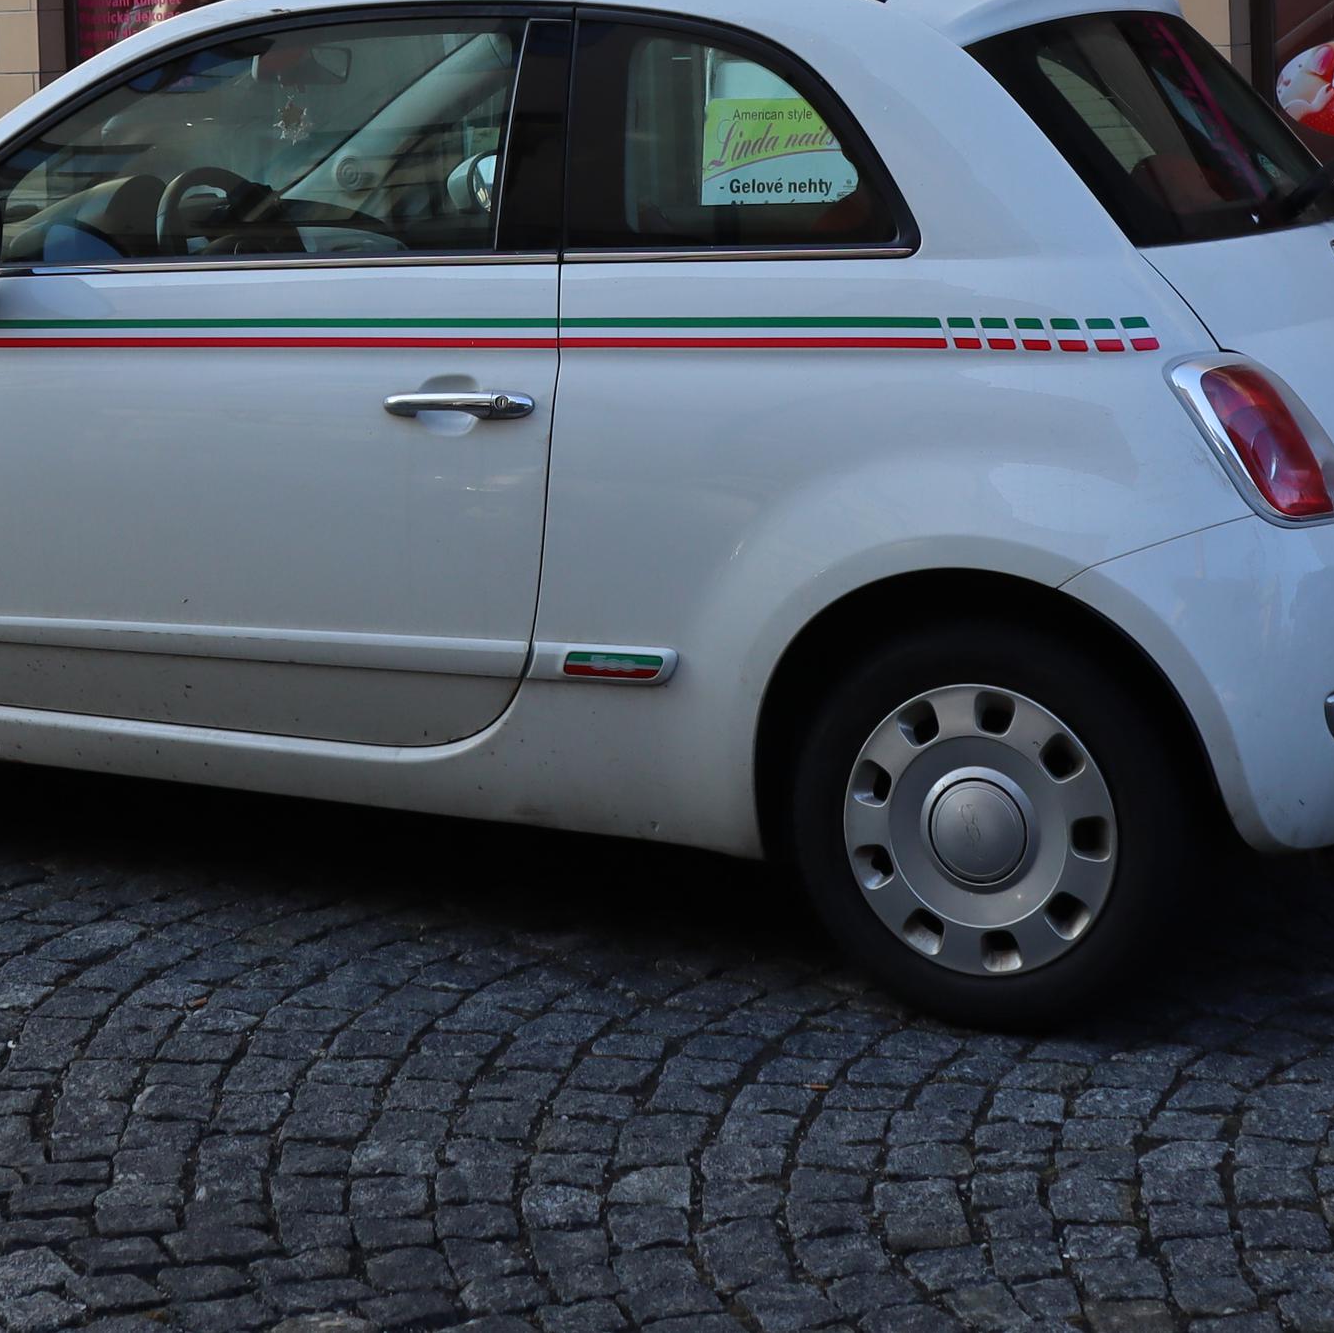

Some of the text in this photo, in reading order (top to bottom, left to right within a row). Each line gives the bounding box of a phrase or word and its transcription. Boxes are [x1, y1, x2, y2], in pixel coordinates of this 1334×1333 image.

[732, 108, 813, 122] American style
[703, 118, 779, 171] Linda
[729, 178, 783, 194] Gelové
[788, 178, 832, 197] nehty
